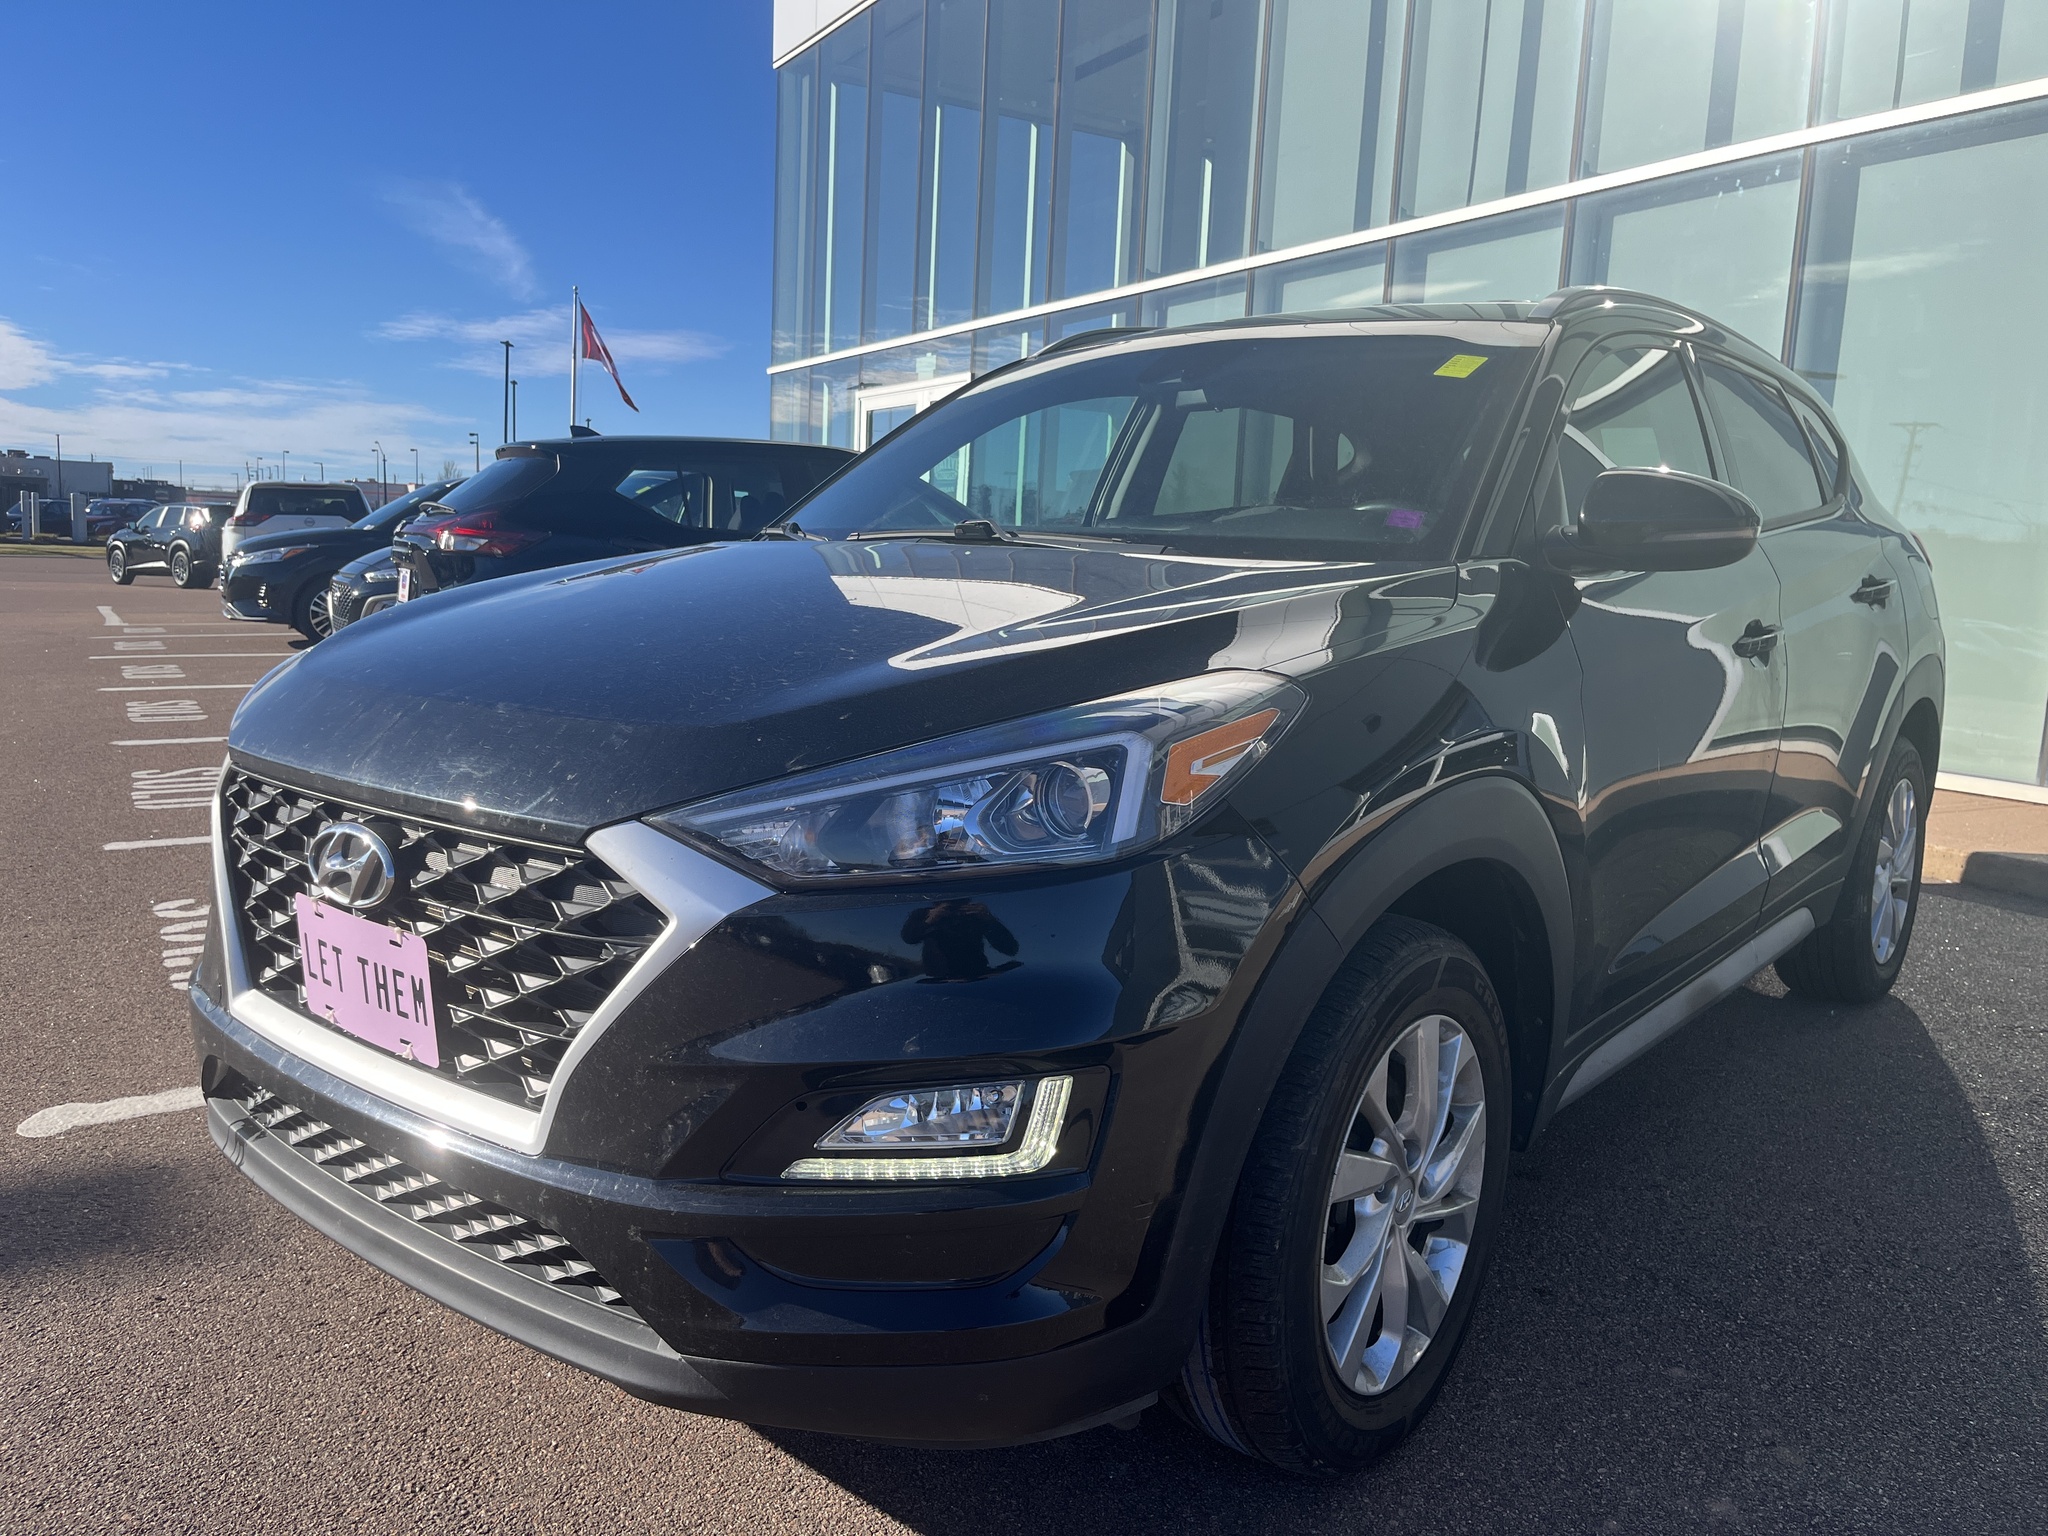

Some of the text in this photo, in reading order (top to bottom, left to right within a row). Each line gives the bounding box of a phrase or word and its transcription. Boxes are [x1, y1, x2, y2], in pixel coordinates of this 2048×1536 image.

[125, 699, 208, 722] SOLD
[304, 932, 428, 1027] LET THEM
